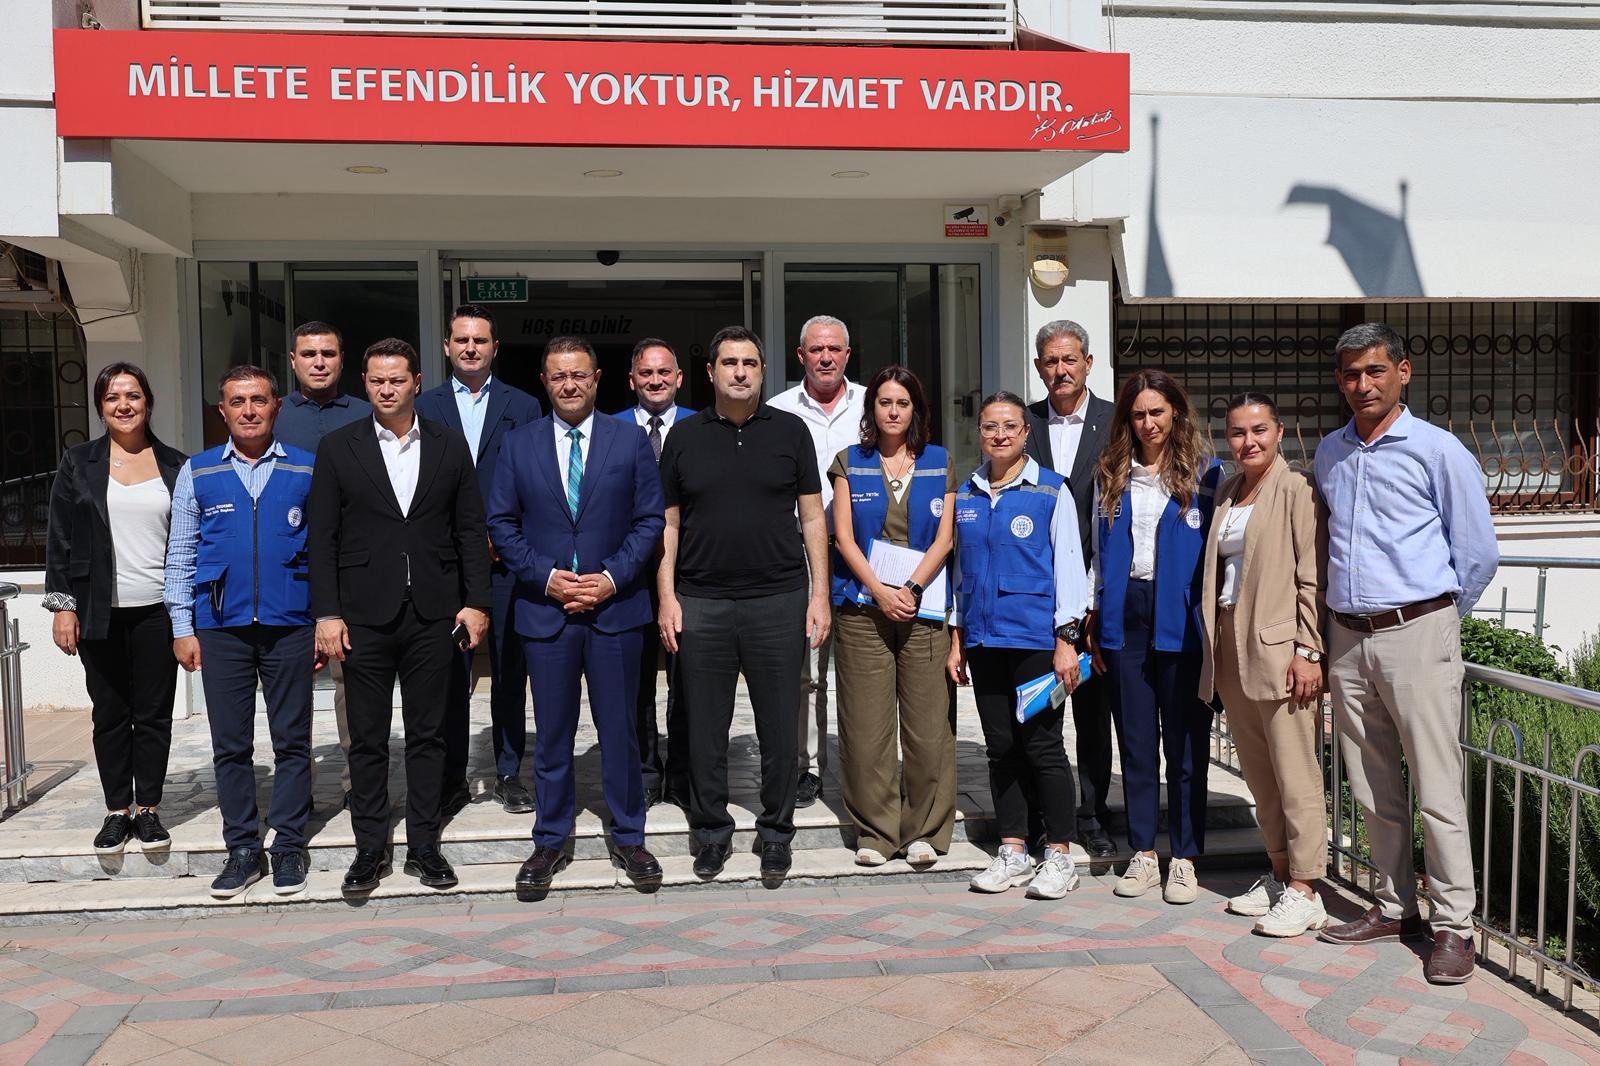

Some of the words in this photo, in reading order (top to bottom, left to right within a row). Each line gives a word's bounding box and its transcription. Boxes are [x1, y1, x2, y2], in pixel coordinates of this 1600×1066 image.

[129, 56, 308, 99] MİLLETE
[331, 63, 546, 103] EFENDİLİK
[565, 72, 740, 111] YOKTUR,
[754, 69, 903, 109] HİZMET
[920, 79, 1073, 112] VARDIR.
[477, 282, 517, 291] EXIT
[521, 318, 555, 338] HOŞ
[560, 314, 633, 335] GELDİNİZ
